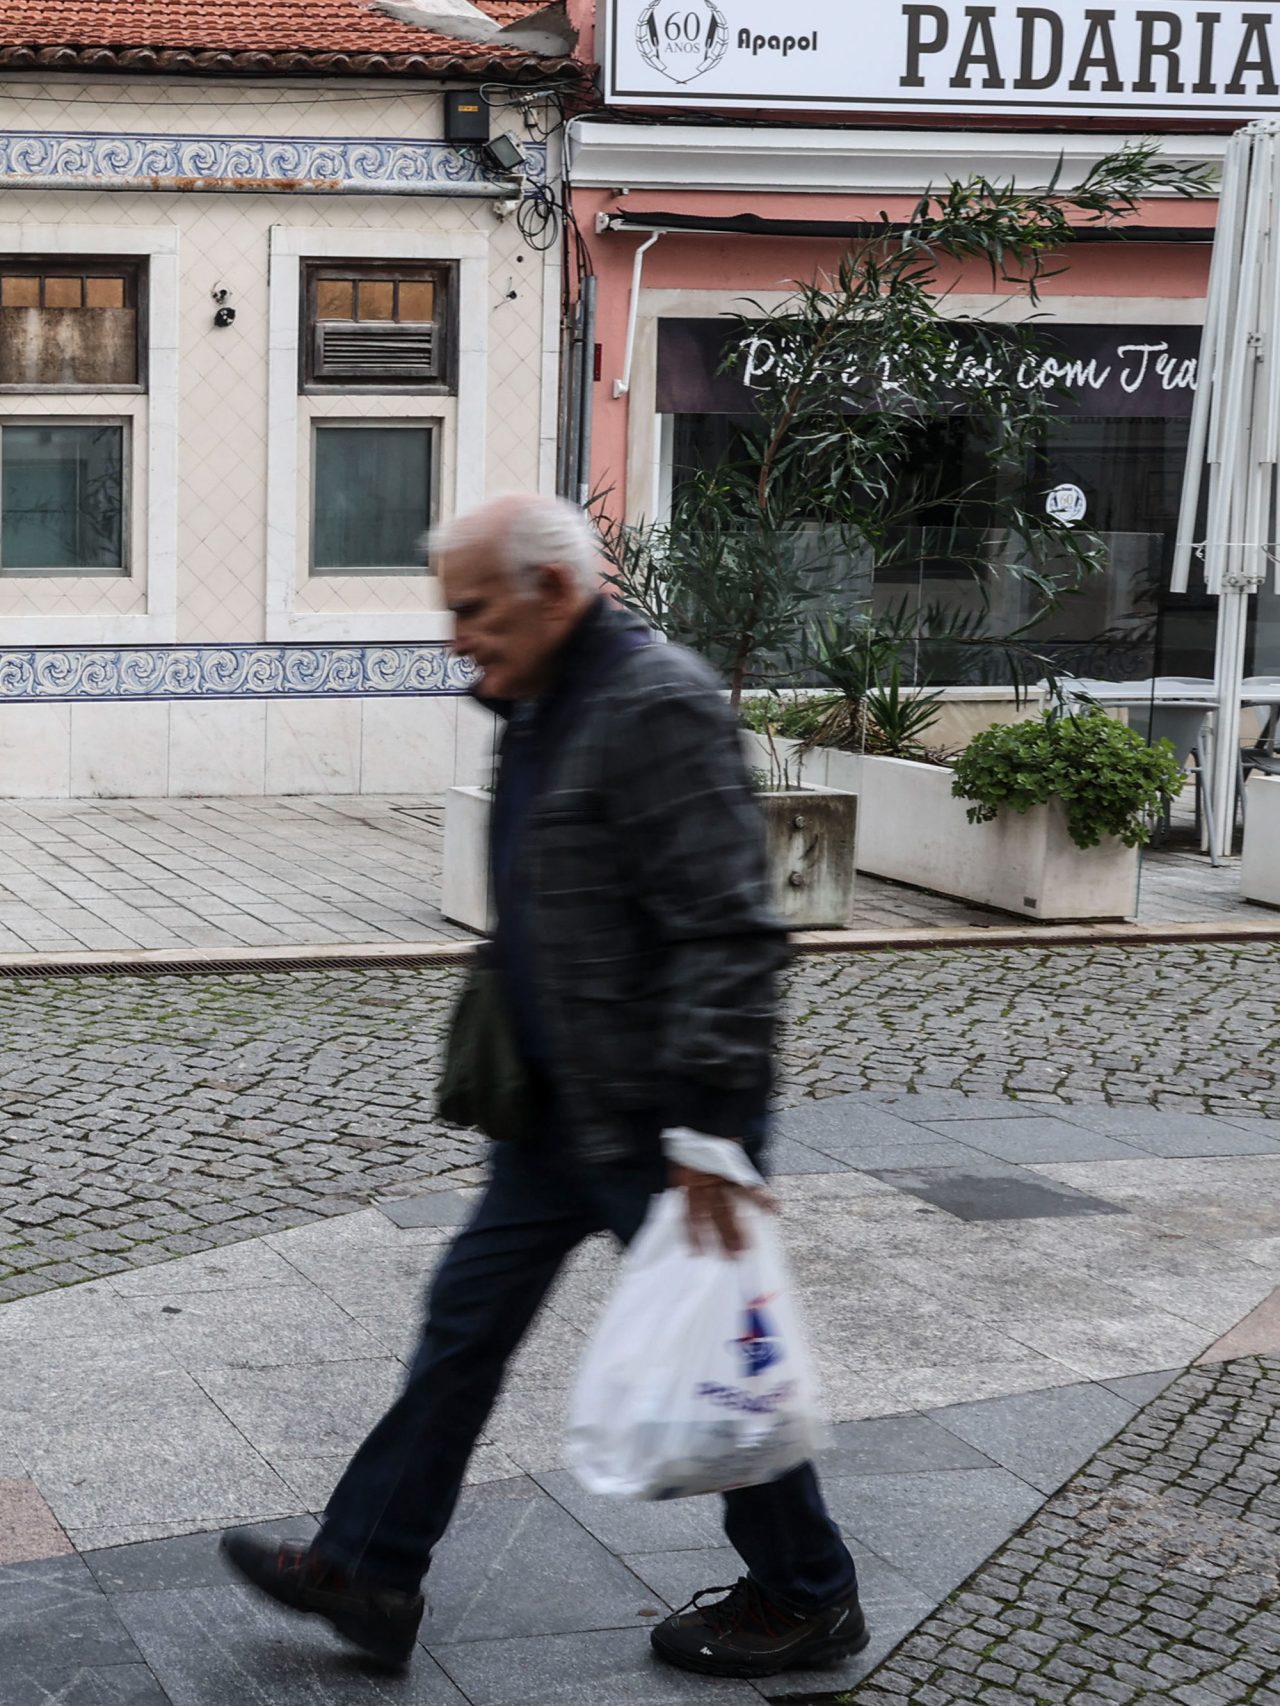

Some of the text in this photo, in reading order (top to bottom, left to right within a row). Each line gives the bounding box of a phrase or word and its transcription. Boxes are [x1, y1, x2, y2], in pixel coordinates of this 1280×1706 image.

[664, 11, 701, 41] 60
[664, 42, 701, 54] ANOS
[737, 27, 818, 56] Apapol
[899, 3, 1279, 95] PADARIA
[1017, 349, 1111, 390] com
